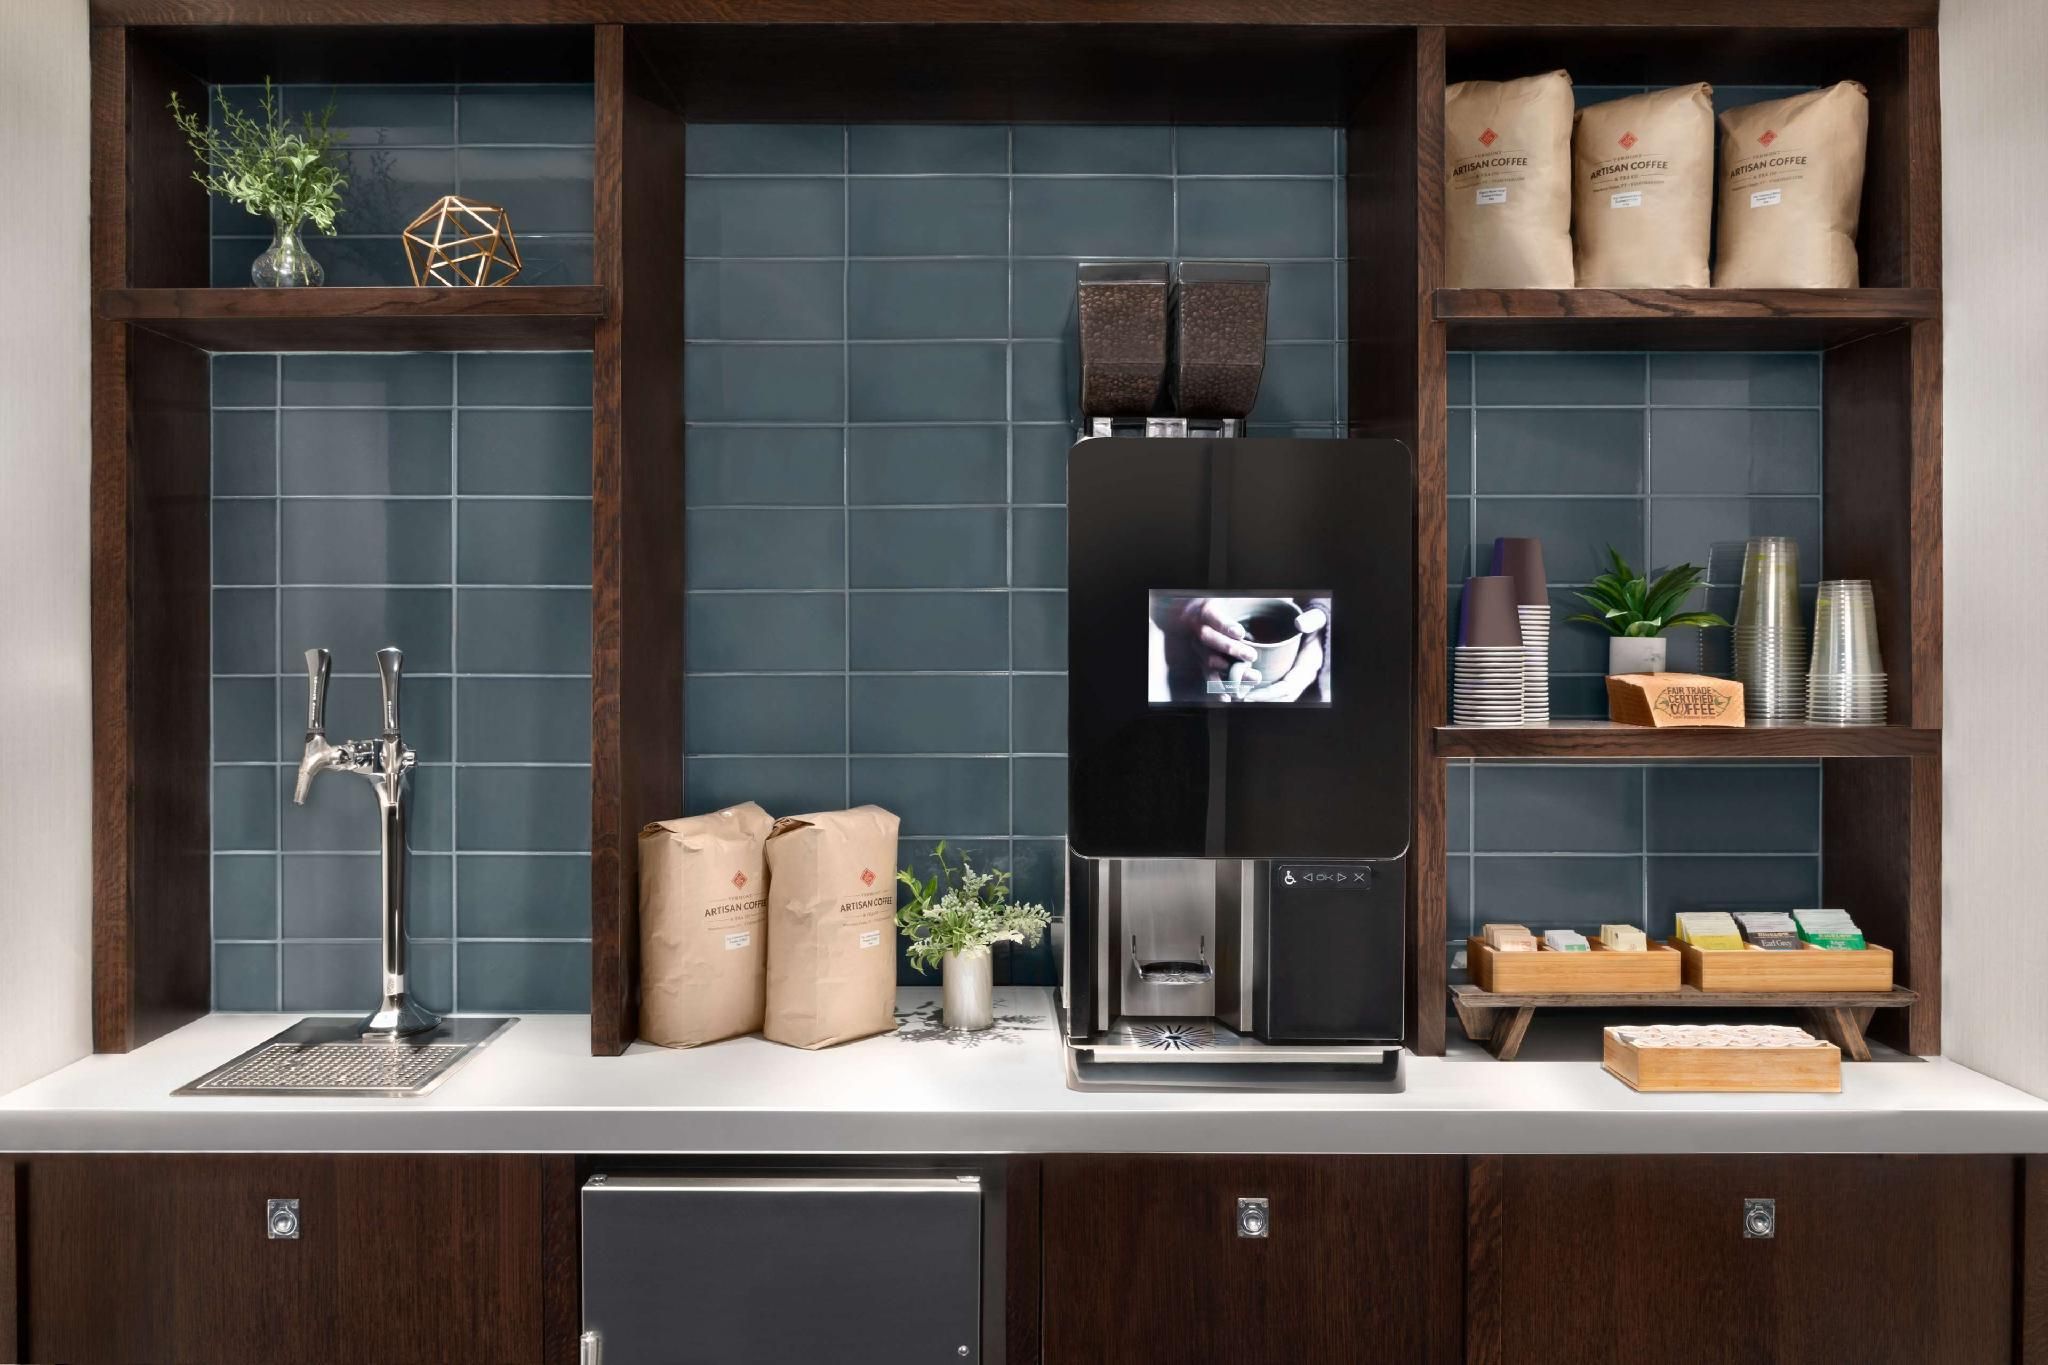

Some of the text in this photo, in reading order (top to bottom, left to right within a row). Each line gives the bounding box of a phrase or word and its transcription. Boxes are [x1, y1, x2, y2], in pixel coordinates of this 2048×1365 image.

[1452, 159, 1489, 177] ARTISAN
[1491, 157, 1528, 167] COFFEE
[1590, 163, 1629, 180] ARTISAN
[1630, 160, 1669, 170] COFFEE
[1730, 161, 1767, 179] ARTISAN
[1769, 156, 1808, 167] COFFEE
[1667, 686, 1712, 695] FAIR TRADE
[1668, 694, 1714, 704] CERTIFIED
[1670, 703, 1716, 716] COFFEE
[705, 903, 742, 917] ARTISAN
[840, 899, 873, 913] ARTISAN
[873, 896, 893, 906] COFFEE
[1761, 939, 1793, 947] Earl Grey
